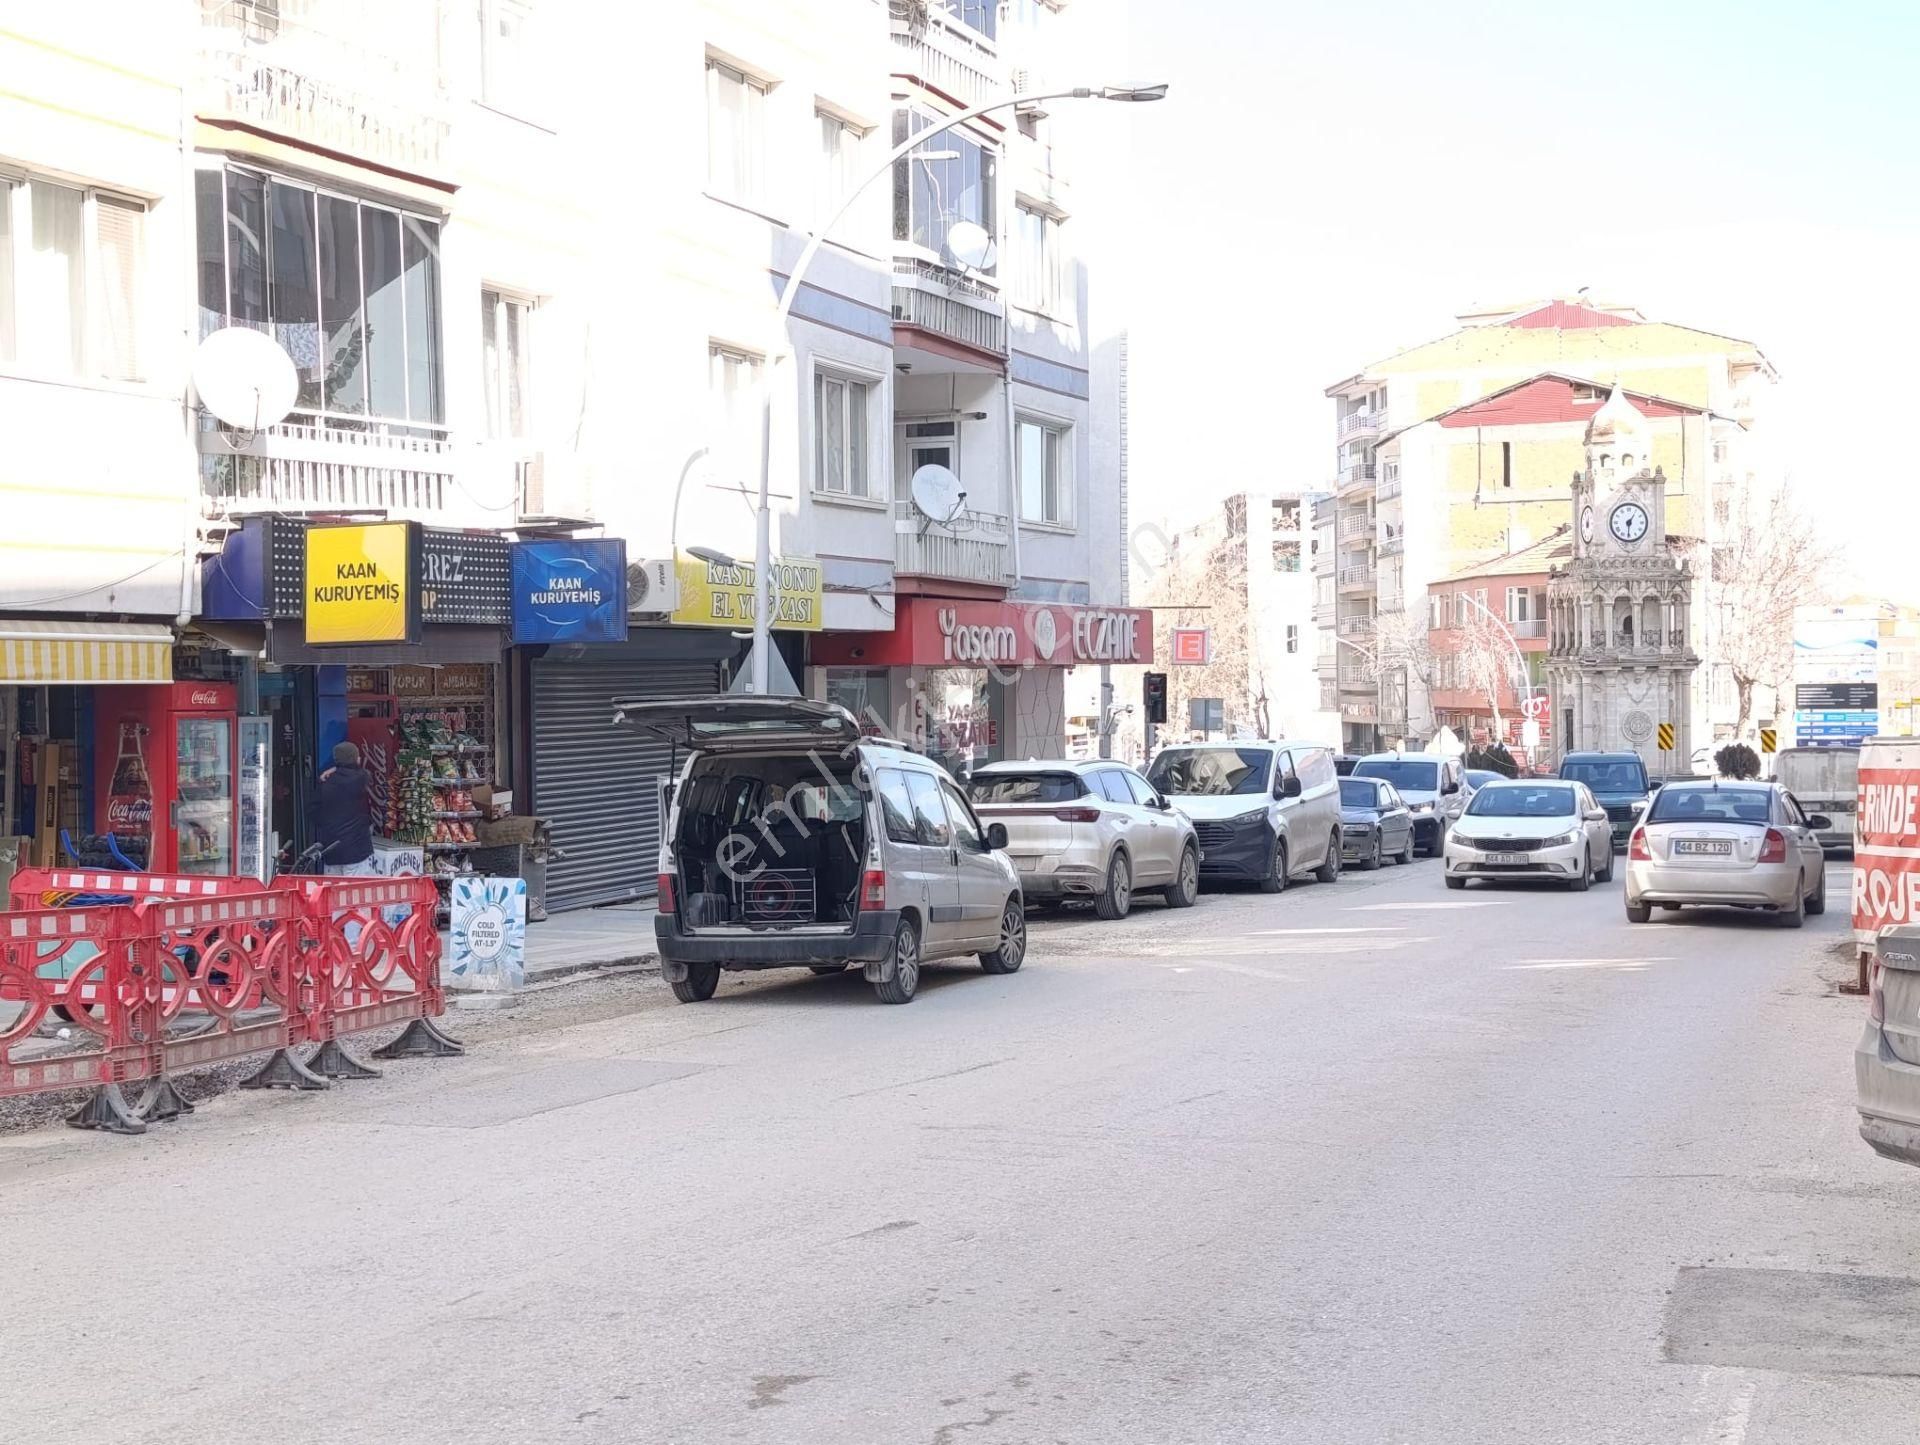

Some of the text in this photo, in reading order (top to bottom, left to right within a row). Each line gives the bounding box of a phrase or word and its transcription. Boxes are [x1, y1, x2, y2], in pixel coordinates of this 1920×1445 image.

[336, 562, 377, 580] KAAN
[314, 580, 400, 604] KURUYEMİŞ
[549, 577, 582, 590] KAAN
[530, 588, 601, 605] KURUYEMİŞ
[711, 592, 734, 618] EL
[1072, 611, 1140, 660] ECZANE
[1680, 842, 1730, 852] 44 BZ 120
[477, 921, 495, 929] COLD
